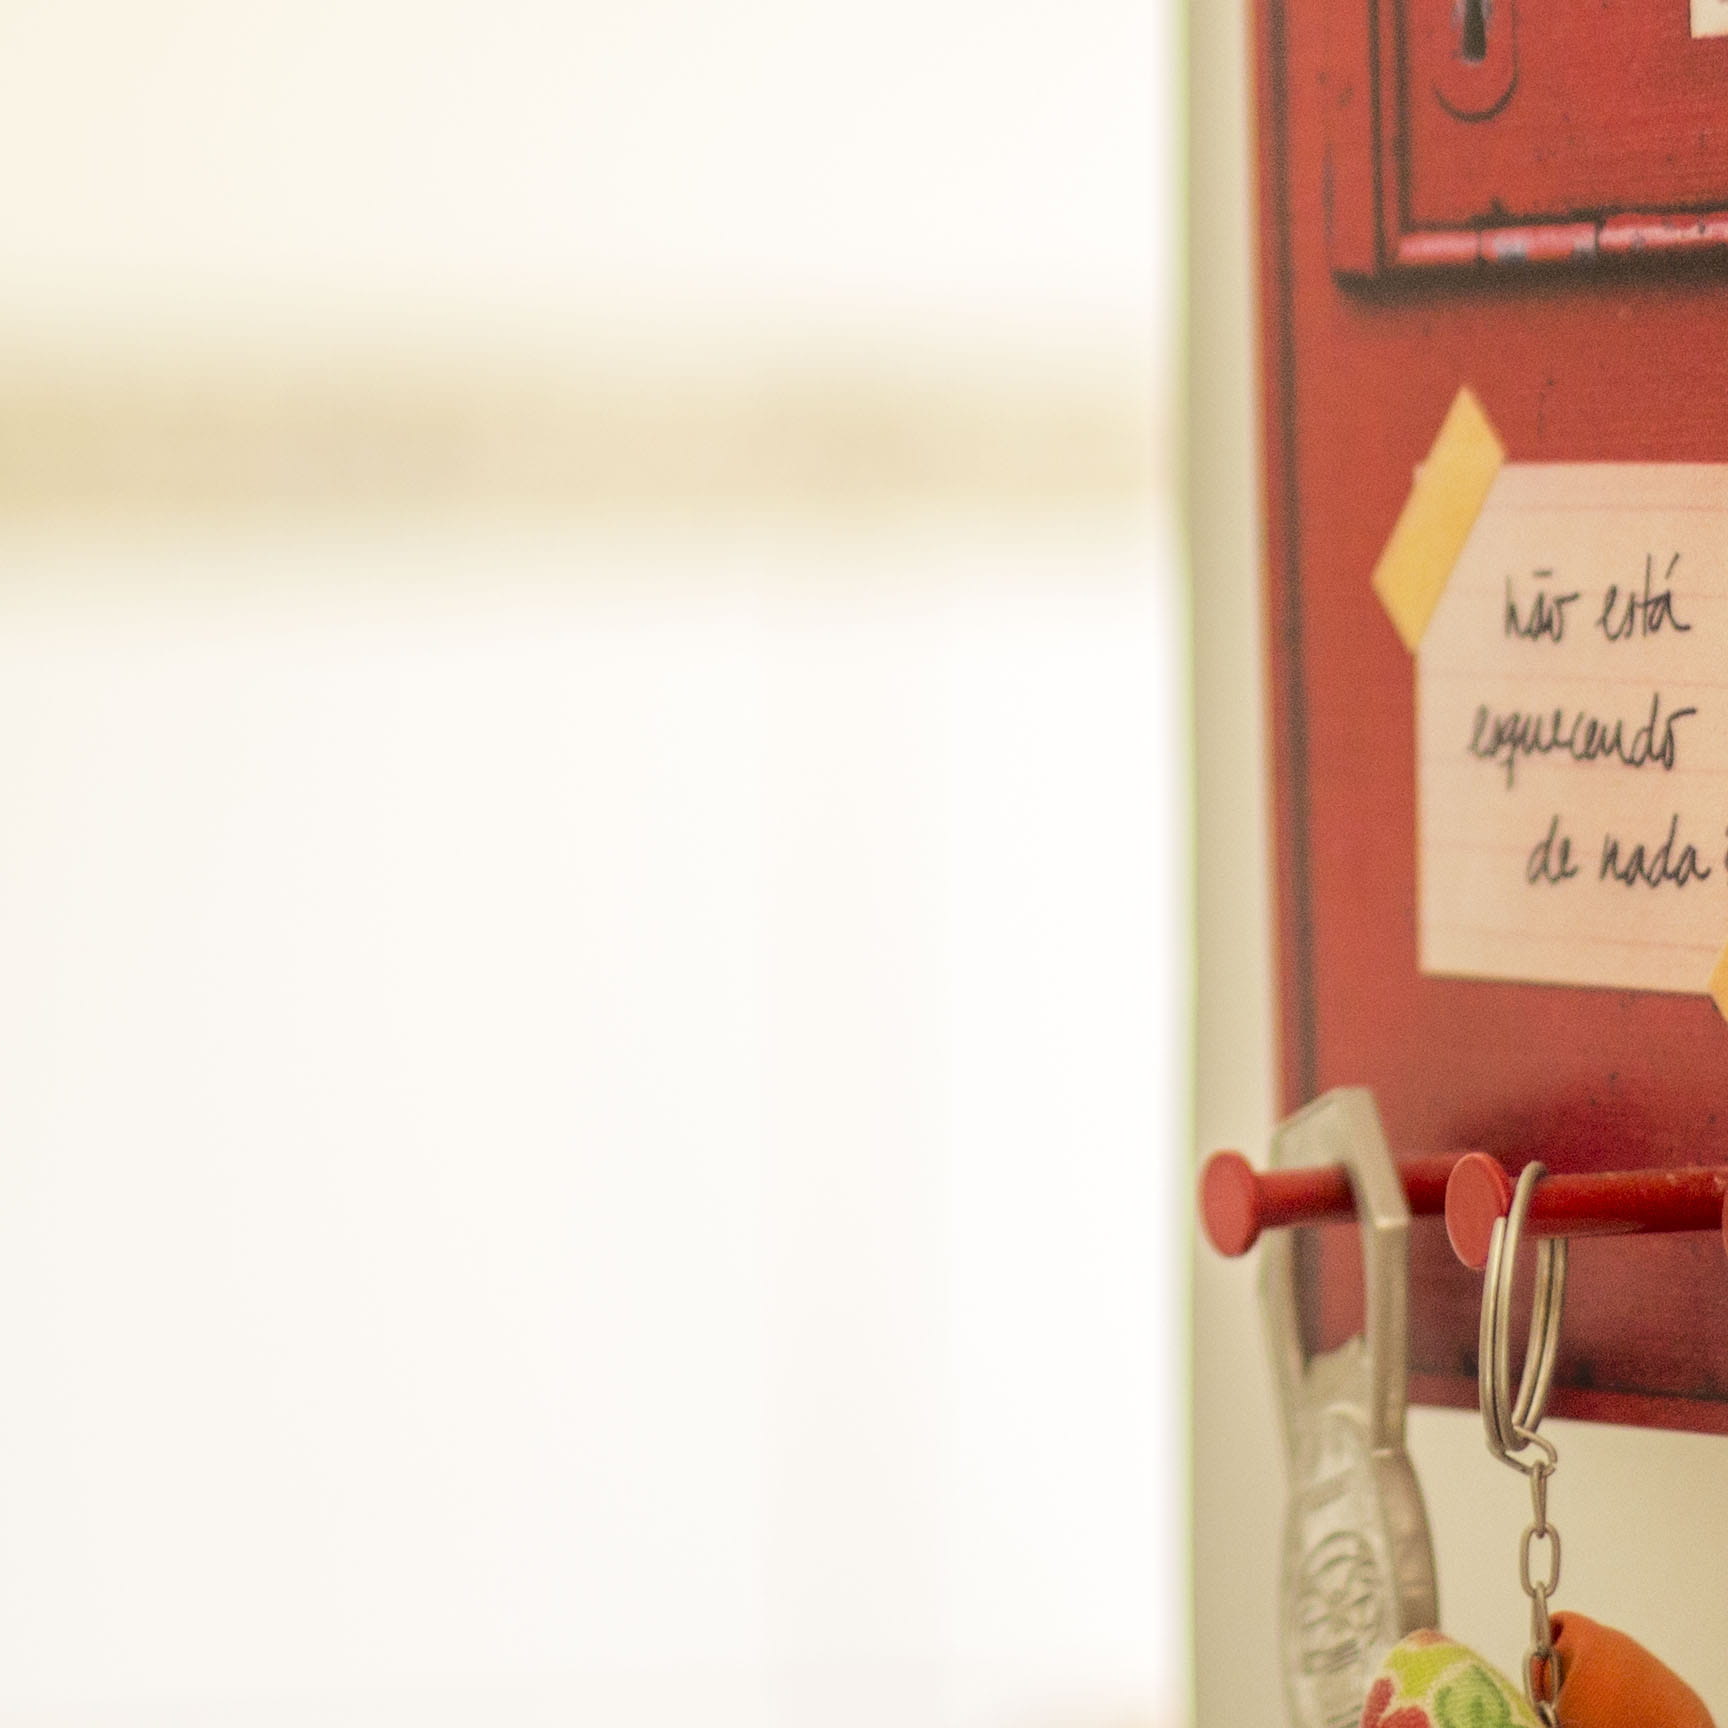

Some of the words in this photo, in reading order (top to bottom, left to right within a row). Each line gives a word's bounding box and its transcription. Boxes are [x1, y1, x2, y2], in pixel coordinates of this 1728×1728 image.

[1504, 569, 1579, 643] não
[1595, 552, 1692, 643] está
[1524, 813, 1579, 886] de
